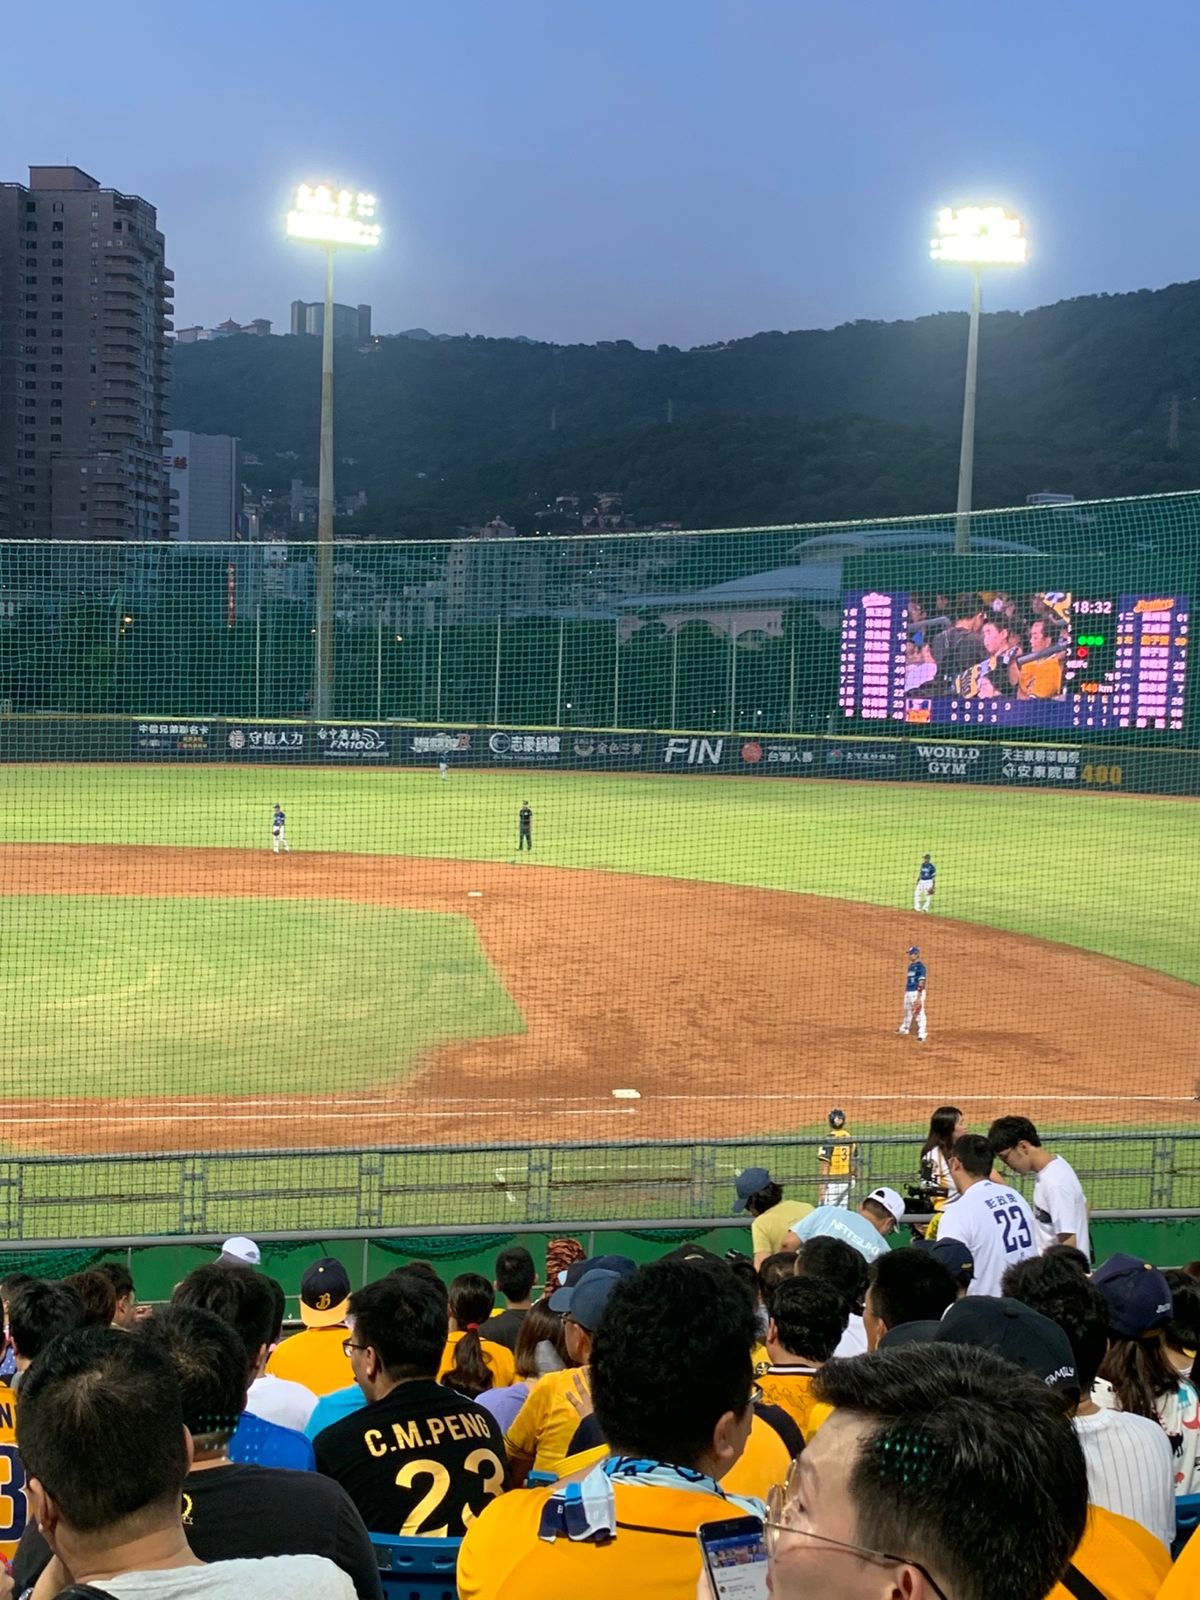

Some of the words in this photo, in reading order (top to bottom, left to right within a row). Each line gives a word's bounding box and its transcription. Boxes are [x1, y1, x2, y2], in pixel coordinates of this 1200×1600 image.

[1072, 601, 1112, 614] 18:32
[249, 731, 304, 745] 守信人力
[330, 740, 386, 750] FM100.7
[663, 738, 723, 764] FIN
[916, 746, 980, 760] WORLD
[928, 762, 967, 775] GYM
[1081, 764, 1123, 784] 400
[993, 1205, 1032, 1253] 23
[1044, 1366, 1075, 1388] FAMILY
[364, 1412, 491, 1457] C.M.PENG
[395, 1447, 505, 1538] 23
